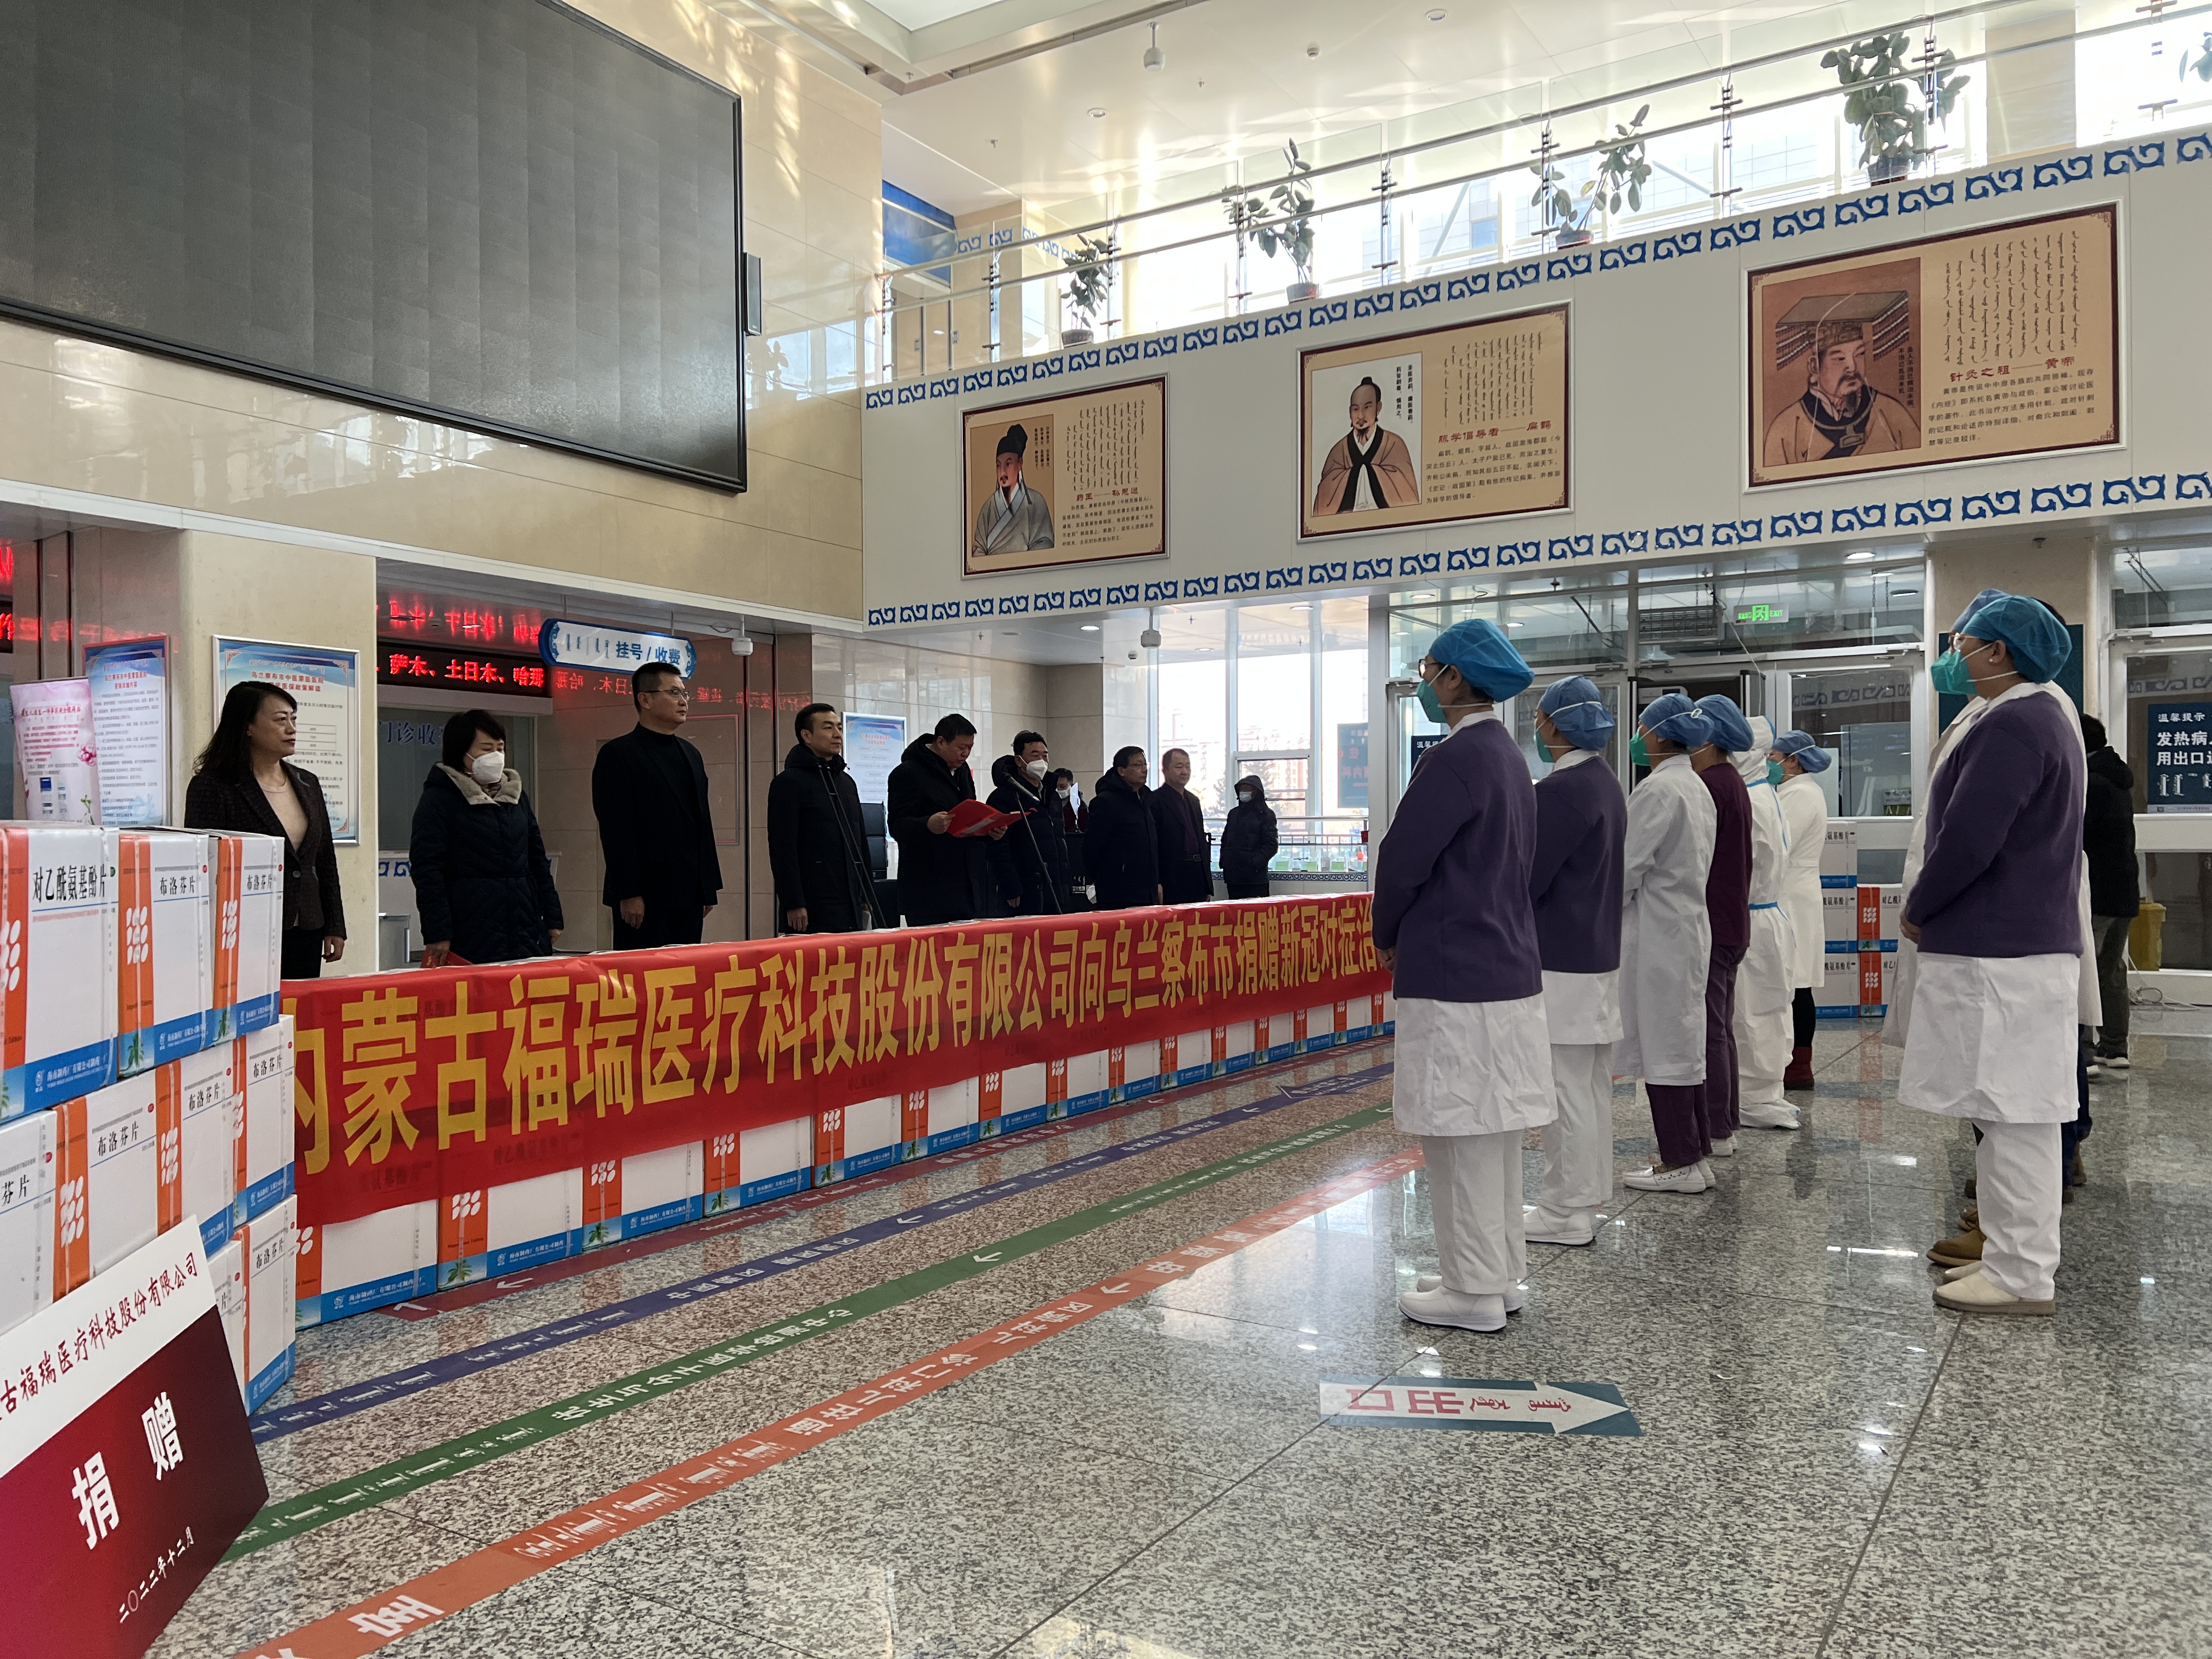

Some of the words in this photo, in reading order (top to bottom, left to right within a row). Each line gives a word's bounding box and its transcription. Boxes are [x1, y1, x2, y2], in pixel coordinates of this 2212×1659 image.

[379, 721, 443, 746] 门诊收
[2158, 713, 2205, 723] 温馨提示
[32, 864, 106, 903] 对乙酰氨基酚片
[160, 875, 196, 896] 布洛芬片
[247, 873, 273, 891] 布洛芬片
[253, 1054, 283, 1078] 布洛芬片
[188, 1082, 220, 1112] 布洛芬片
[97, 1120, 139, 1157] 布洛芬片
[256, 1237, 285, 1269] 布洛芬片
[667, 1267, 765, 1301] 中医病区
[772, 1237, 860, 1266] 蒙医病区
[1146, 1232, 1254, 1274] 母婴室
[0, 1252, 198, 1421] 古福瑞医疗科技股份有限公司
[551, 1308, 853, 1422] 优生与分子医学检测中心
[783, 1353, 979, 1436] 通往儿科门诊
[991, 1300, 1093, 1345] 儿科病区
[1346, 1388, 1464, 1415] 出口
